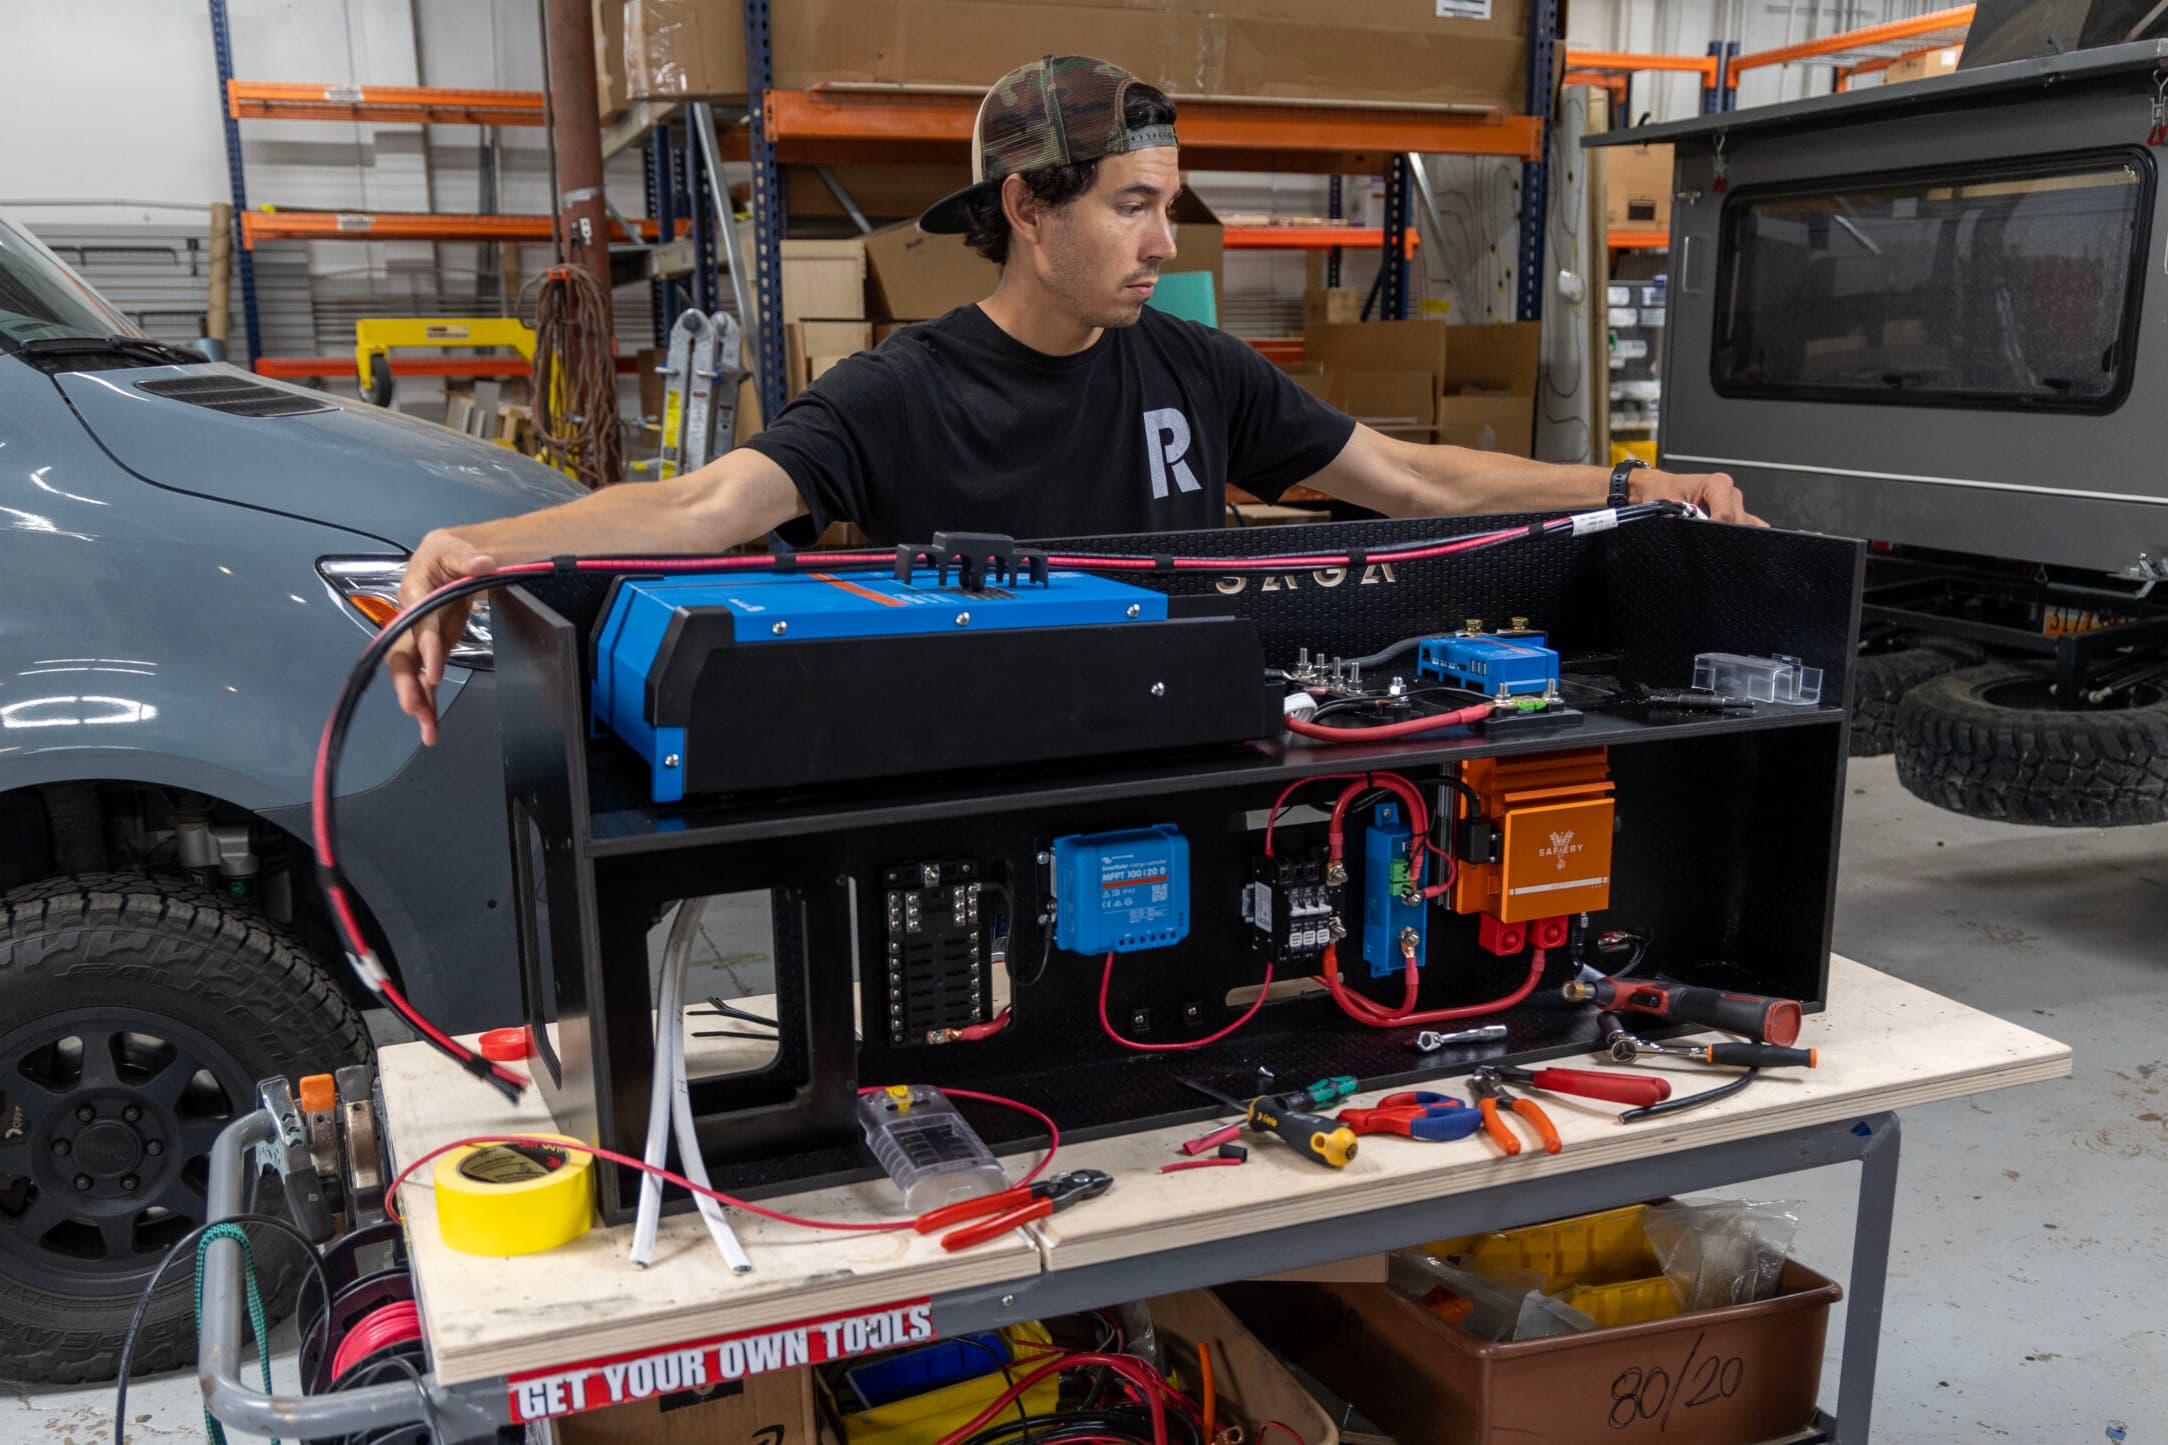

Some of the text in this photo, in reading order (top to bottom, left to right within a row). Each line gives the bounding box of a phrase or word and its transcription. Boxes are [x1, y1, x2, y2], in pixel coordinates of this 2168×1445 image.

[1102, 871, 1125, 881] MPPT
[518, 1305, 933, 1421] GET YOUR OWN TOOLS
[1607, 1331, 1744, 1432] 80/20
